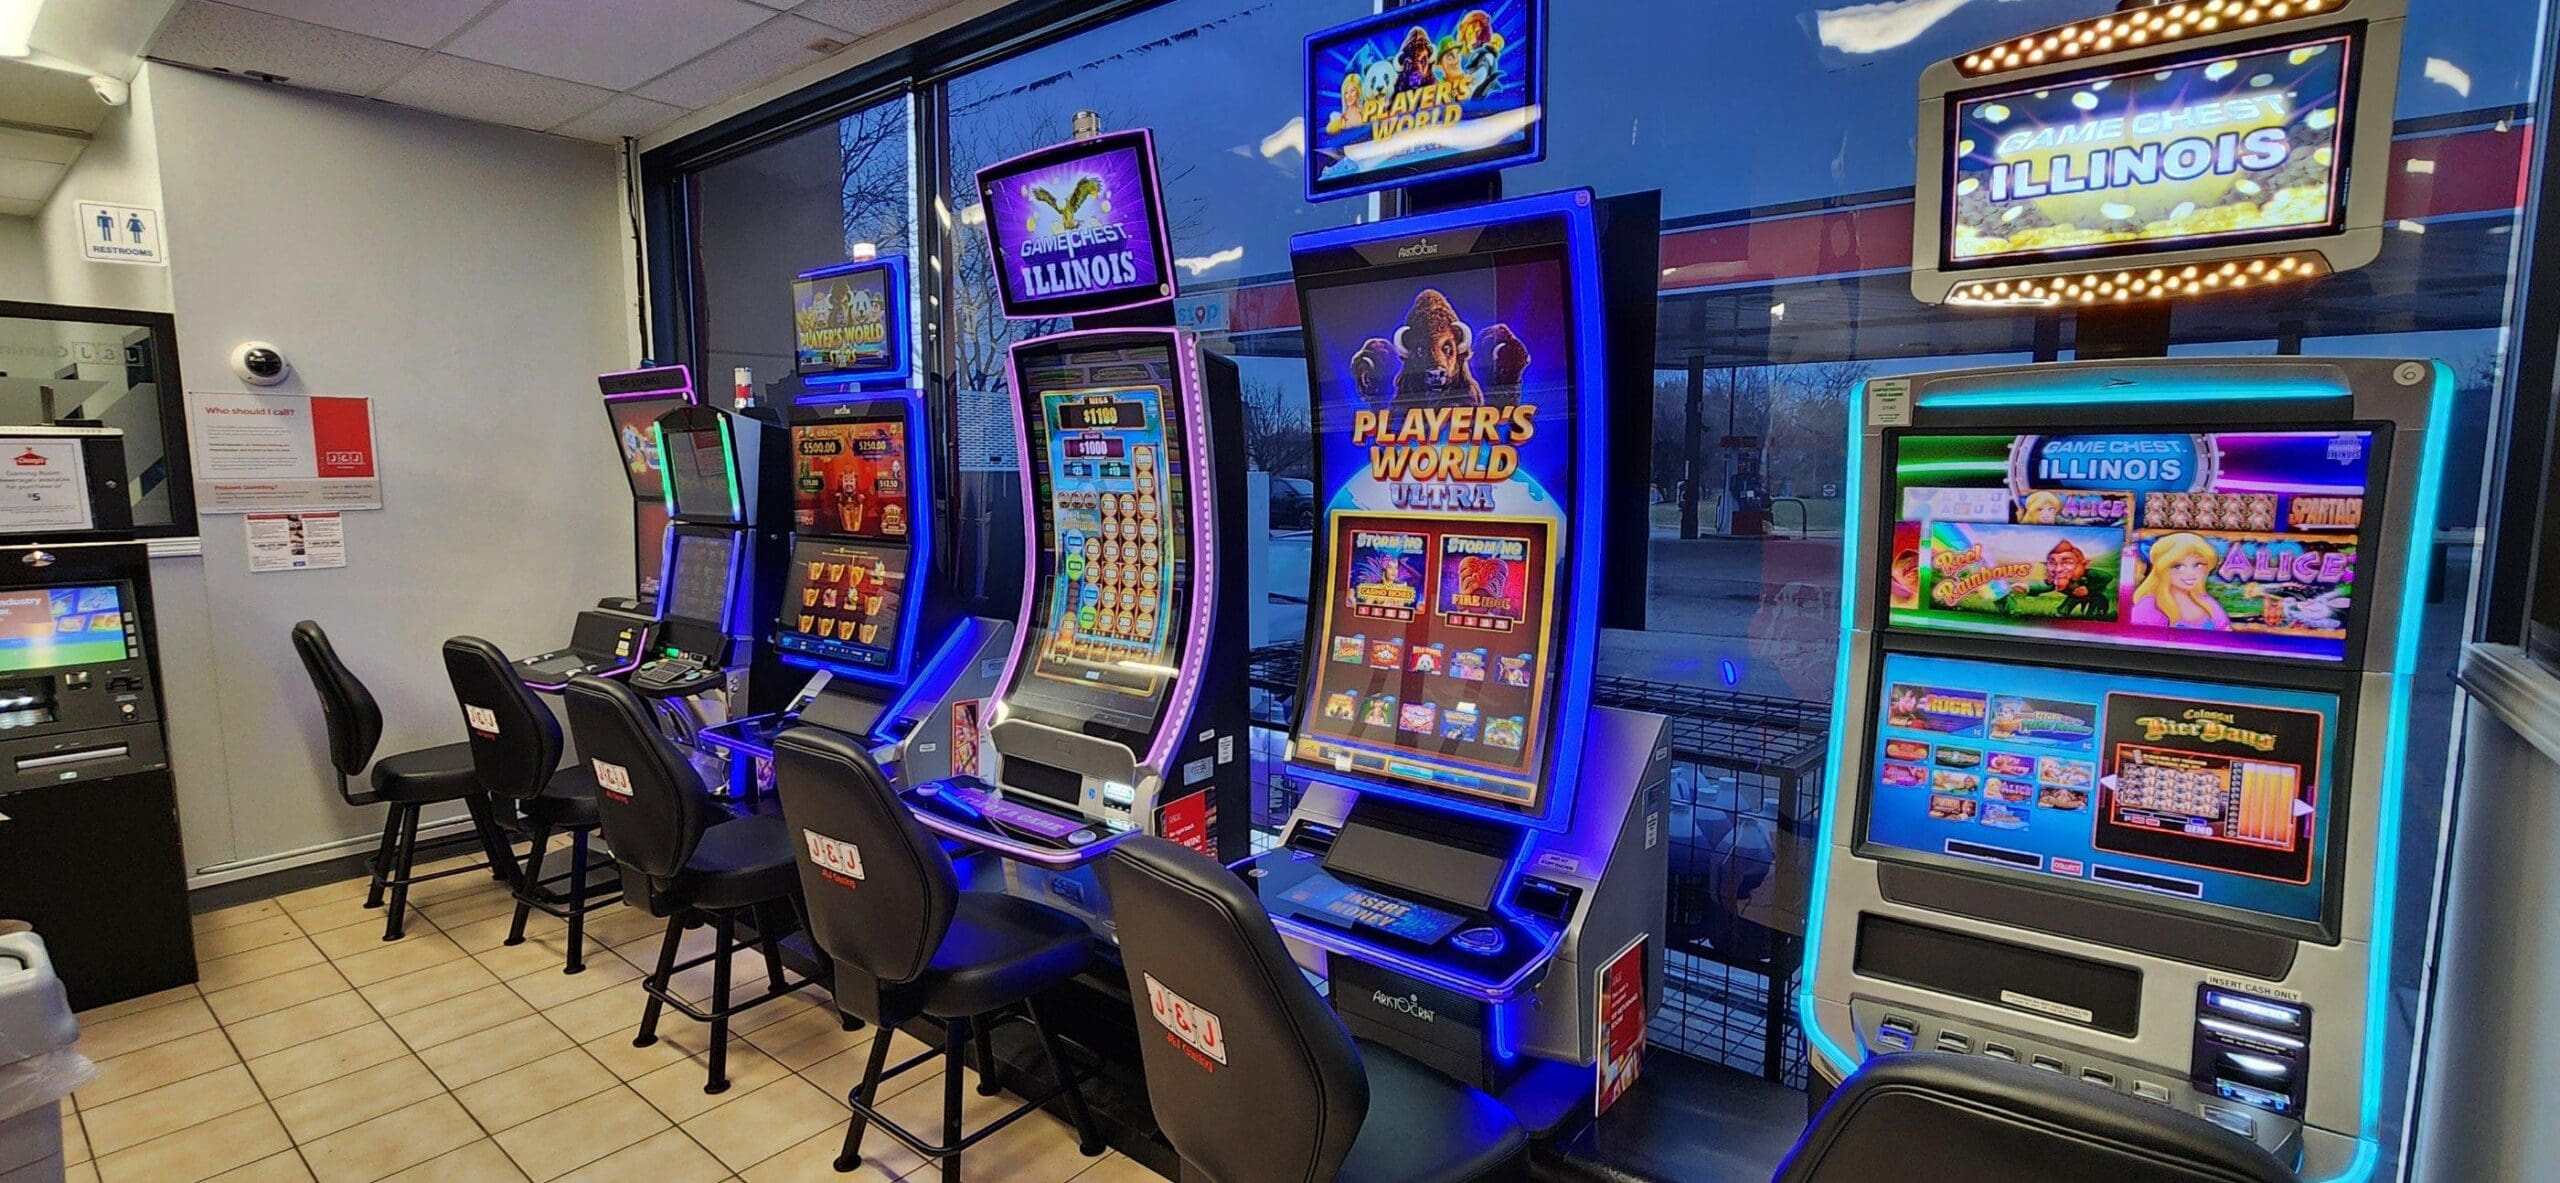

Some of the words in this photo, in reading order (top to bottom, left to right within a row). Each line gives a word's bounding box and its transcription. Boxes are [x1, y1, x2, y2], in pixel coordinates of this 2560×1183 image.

[1362, 76, 1473, 124] PLAYER'S
[1371, 104, 1463, 143] WORLD
[1998, 117, 2123, 153] GAME
[2131, 93, 2290, 134] CHEST
[1989, 126, 2292, 202] ILLINOIS
[93, 245, 154, 257] RESTROOMS
[1020, 233, 1069, 257] GAME
[1070, 223, 1128, 250] CHEST
[1020, 251, 1137, 297] ILLINOIS
[843, 322, 885, 343] WORLD
[2403, 365, 2416, 381] 6
[205, 407, 229, 415] Who
[231, 408, 266, 416] should
[273, 408, 295, 416] call?
[1083, 406, 1118, 425] $1100
[1352, 403, 1539, 446] PLAYER'S
[803, 441, 836, 454] $500.00
[1078, 439, 1108, 456] $1000
[2043, 440, 2106, 454] GAME
[2108, 440, 2181, 453] CHEST
[1368, 445, 1520, 484] WORLD
[2038, 458, 2182, 481] ILLINOIS
[1389, 483, 1496, 513] ULTRA
[2060, 494, 2130, 519] ALICE
[1933, 543, 1983, 576] Reel
[2217, 542, 2348, 584] ALICE
[1931, 560, 2034, 607] Rainbows
[2182, 708, 2235, 724] Colossal
[812, 838, 856, 870] J&J
[1326, 900, 1397, 927] MONEY
[1343, 891, 1411, 918] INSERT
[2208, 976, 2243, 989] INSERT
[2245, 983, 2272, 995] CASH
[2274, 989, 2299, 1000] ONLY
[1156, 989, 1216, 1048] J&J
[1372, 988, 1437, 1023] ARISTOCRAT
